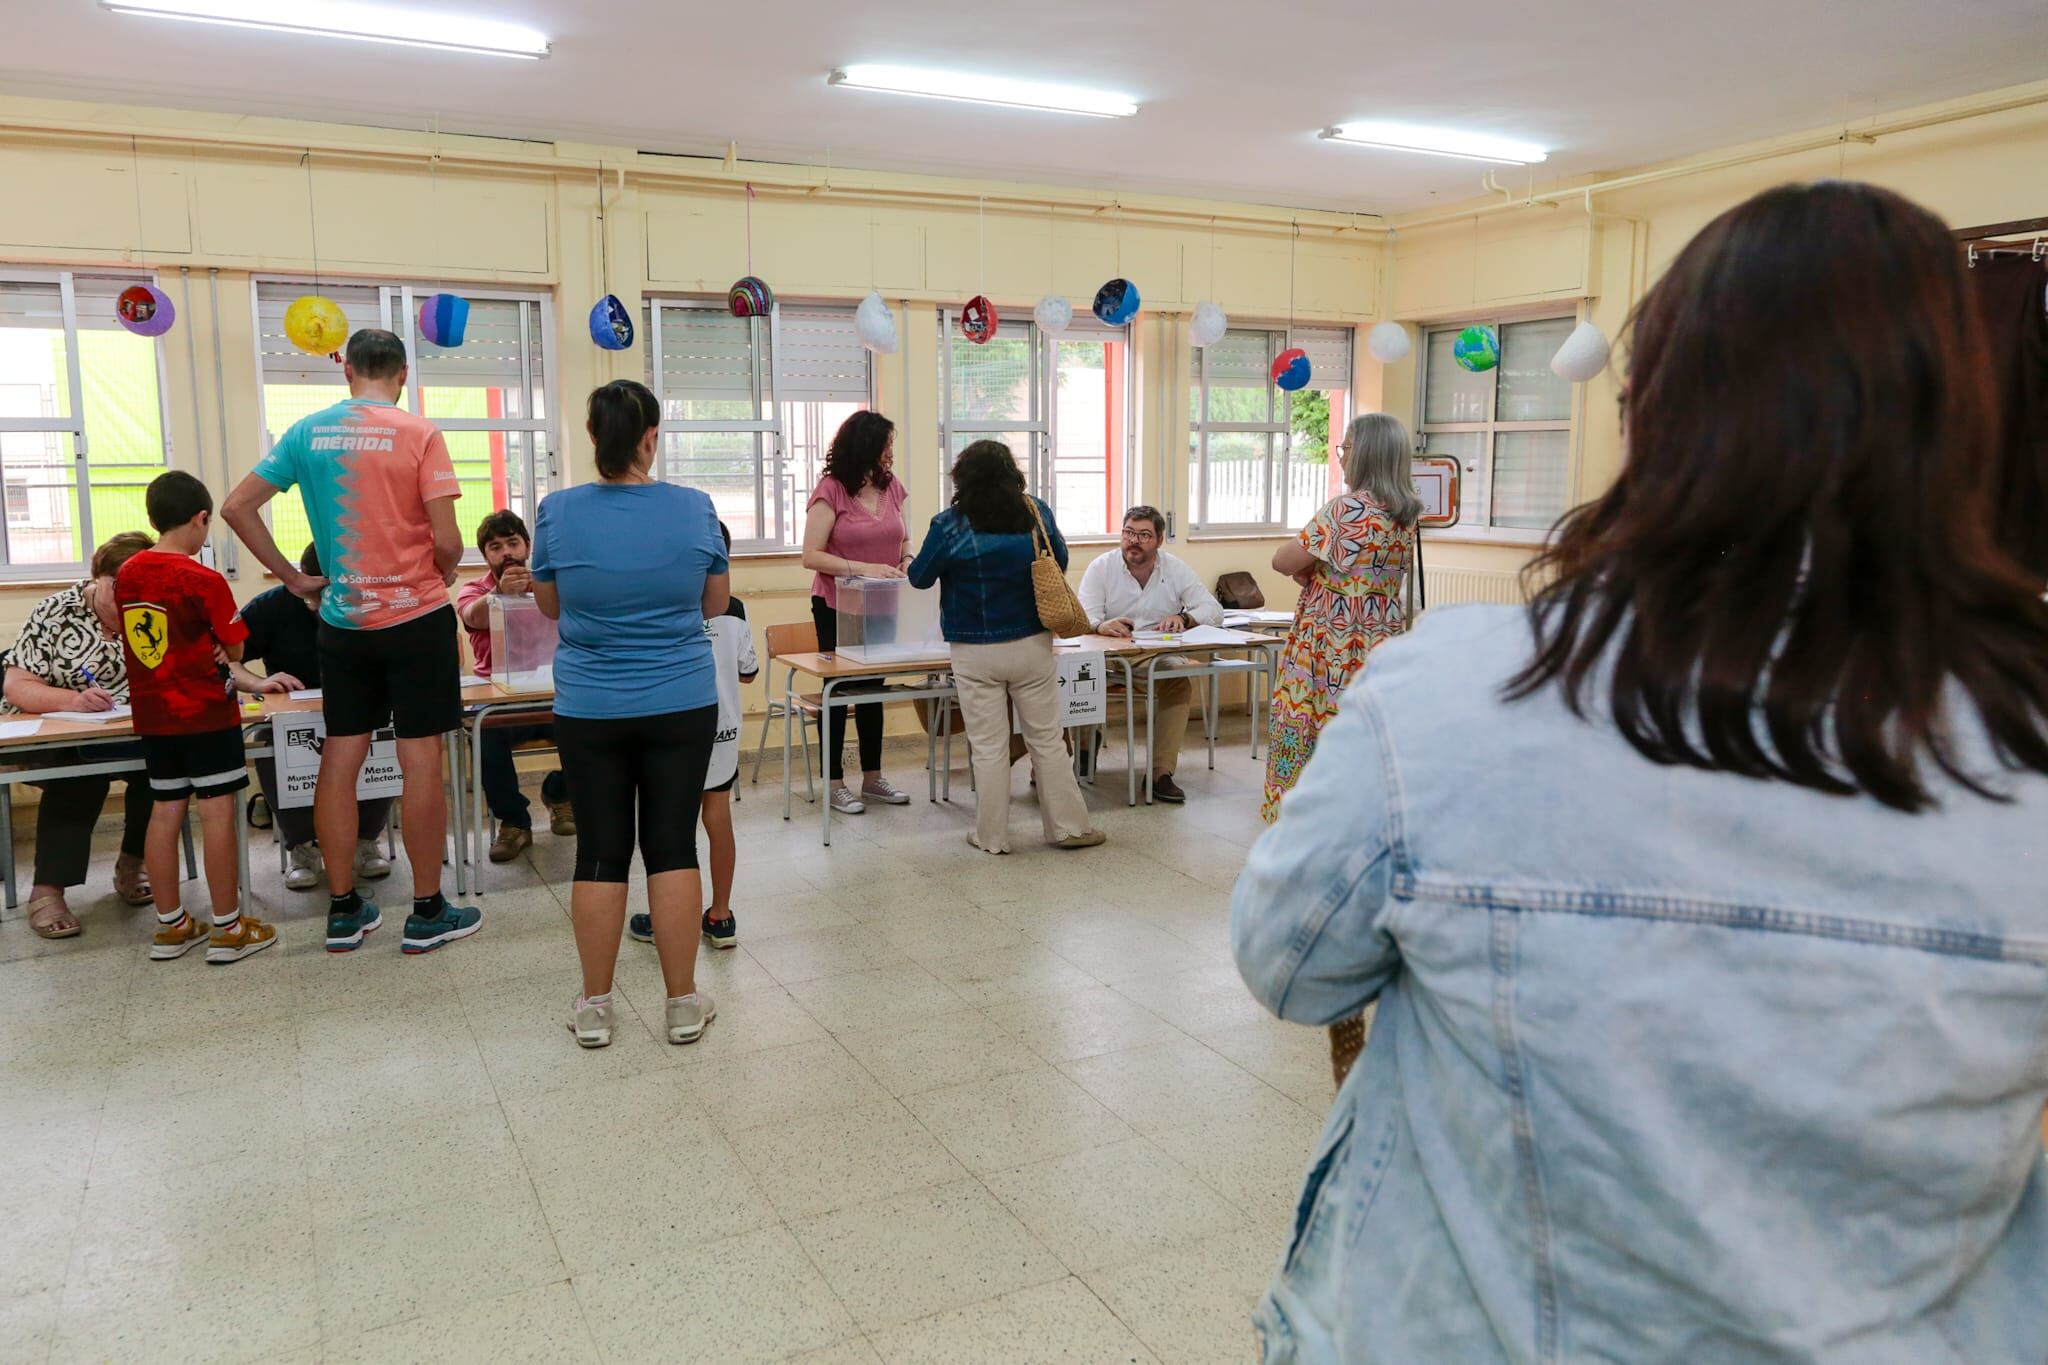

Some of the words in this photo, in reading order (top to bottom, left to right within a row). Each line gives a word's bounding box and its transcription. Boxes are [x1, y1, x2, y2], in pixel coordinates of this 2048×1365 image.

[349, 574, 402, 584] Santander
[1069, 705, 1097, 715] electoral
[364, 766, 394, 775] Mesa
[287, 773, 319, 782] Muestr
[365, 774, 404, 784] electora
[288, 784, 299, 792] tu
